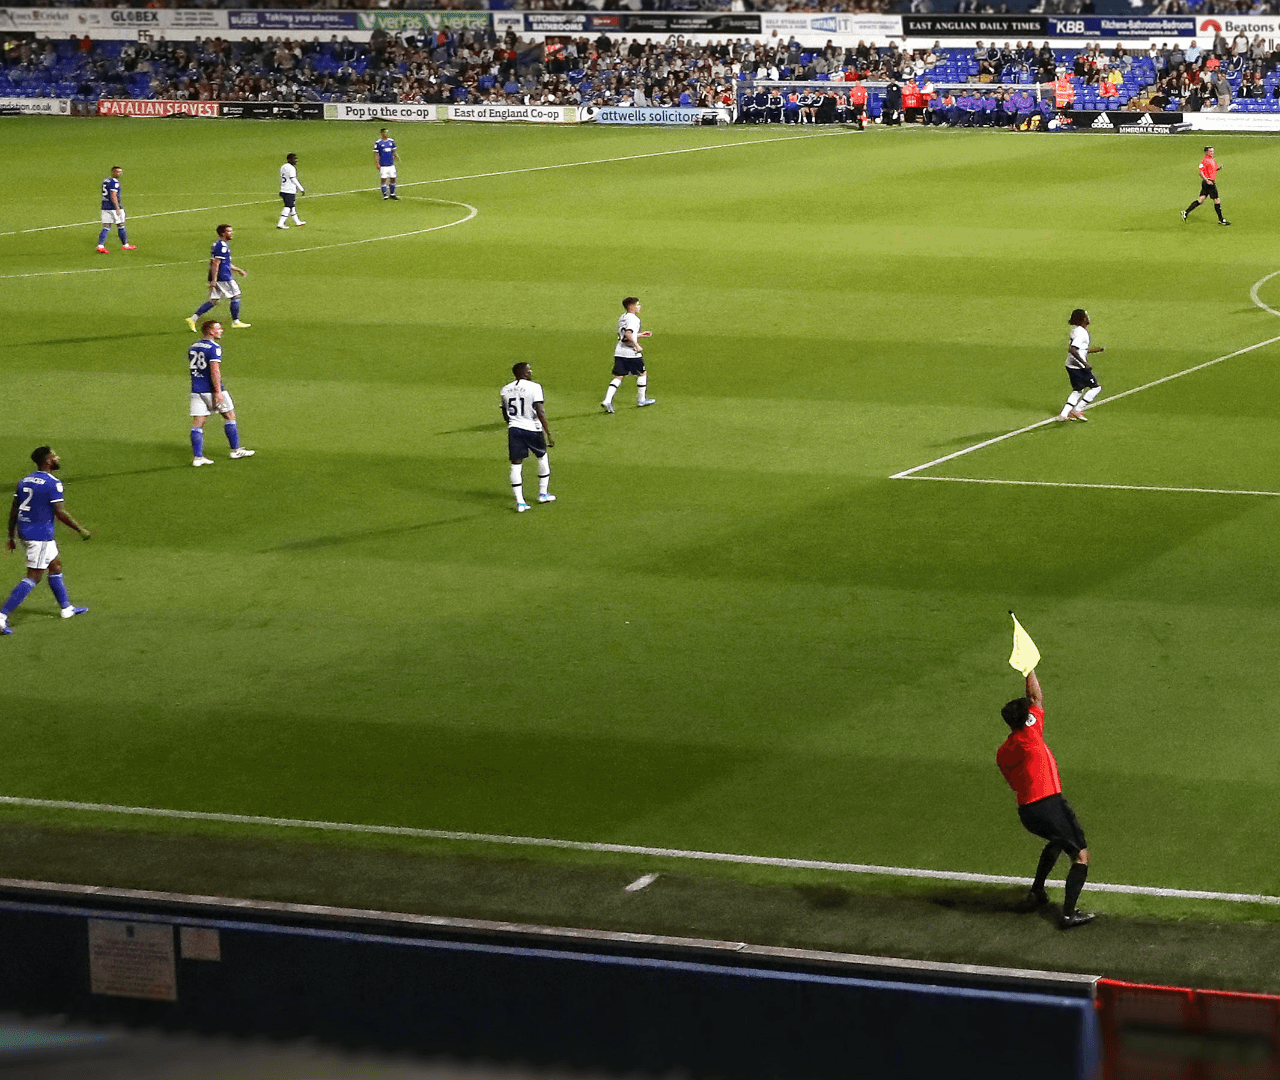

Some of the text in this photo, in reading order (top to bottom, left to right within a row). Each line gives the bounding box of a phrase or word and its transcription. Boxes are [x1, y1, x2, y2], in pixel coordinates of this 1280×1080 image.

[111, 11, 158, 22] GLOBEX
[265, 13, 293, 23] Taking
[378, 17, 422, 29] vertas
[909, 22, 932, 30] EAST
[935, 22, 978, 30] ANGLIAN
[980, 22, 1010, 30] DAILY
[1012, 22, 1041, 31] TIMES
[1057, 21, 1085, 33] KBB
[1225, 21, 1274, 32] Beatons
[111, 103, 163, 115] ATALIAN
[166, 104, 219, 116] SERVEST
[346, 106, 429, 118] Pop to the co-op
[454, 108, 559, 120] East of England Co-op
[601, 109, 699, 122] attwells solicitors
[189, 350, 207, 370] 28
[508, 397, 525, 417] 51
[19, 487, 33, 511] 2
